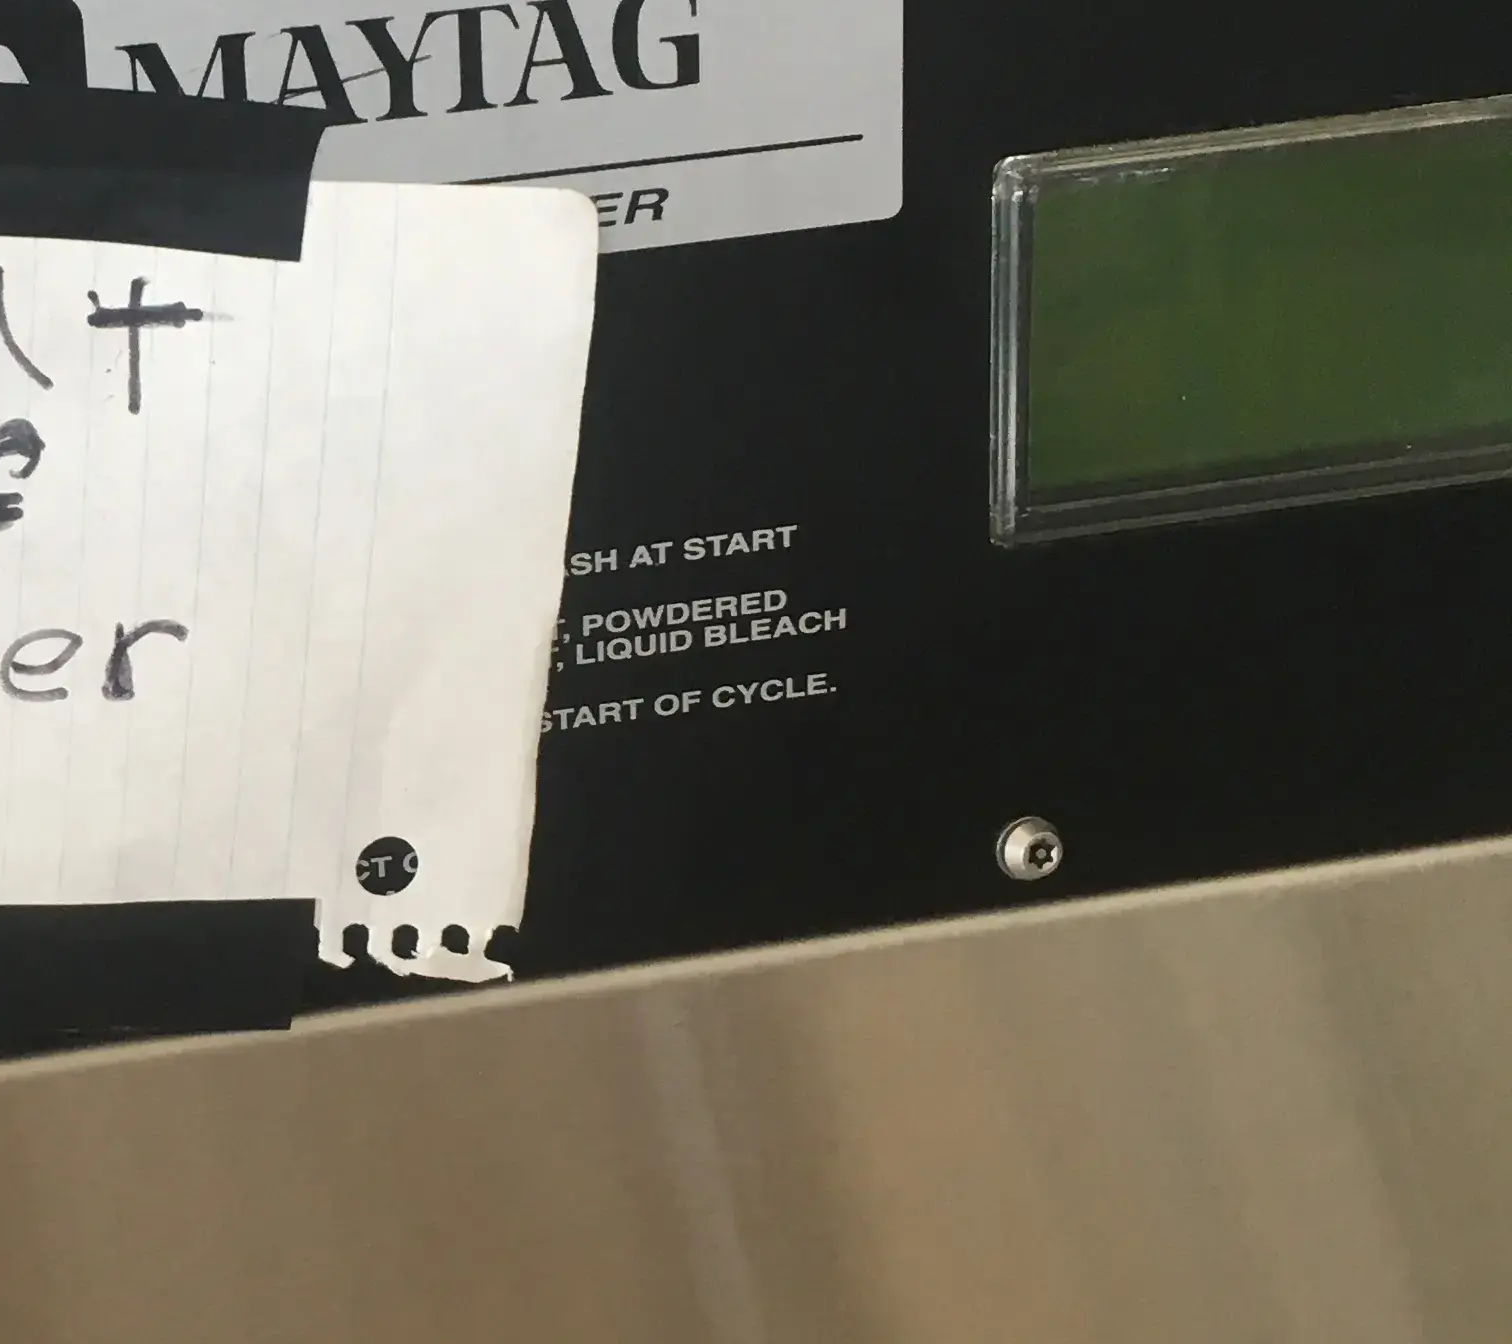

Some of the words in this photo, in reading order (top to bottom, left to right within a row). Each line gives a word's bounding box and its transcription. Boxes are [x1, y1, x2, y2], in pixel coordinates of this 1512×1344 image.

[597, 187, 670, 227] ER
[566, 549, 619, 577] SH
[629, 541, 673, 569] AT
[683, 524, 798, 561] START
[575, 629, 693, 666] LIQUID
[704, 608, 847, 648] BLEACH
[581, 589, 788, 637] POWDERED
[540, 698, 644, 733] START
[654, 690, 702, 717] OF
[712, 672, 838, 709] CYCLE.
